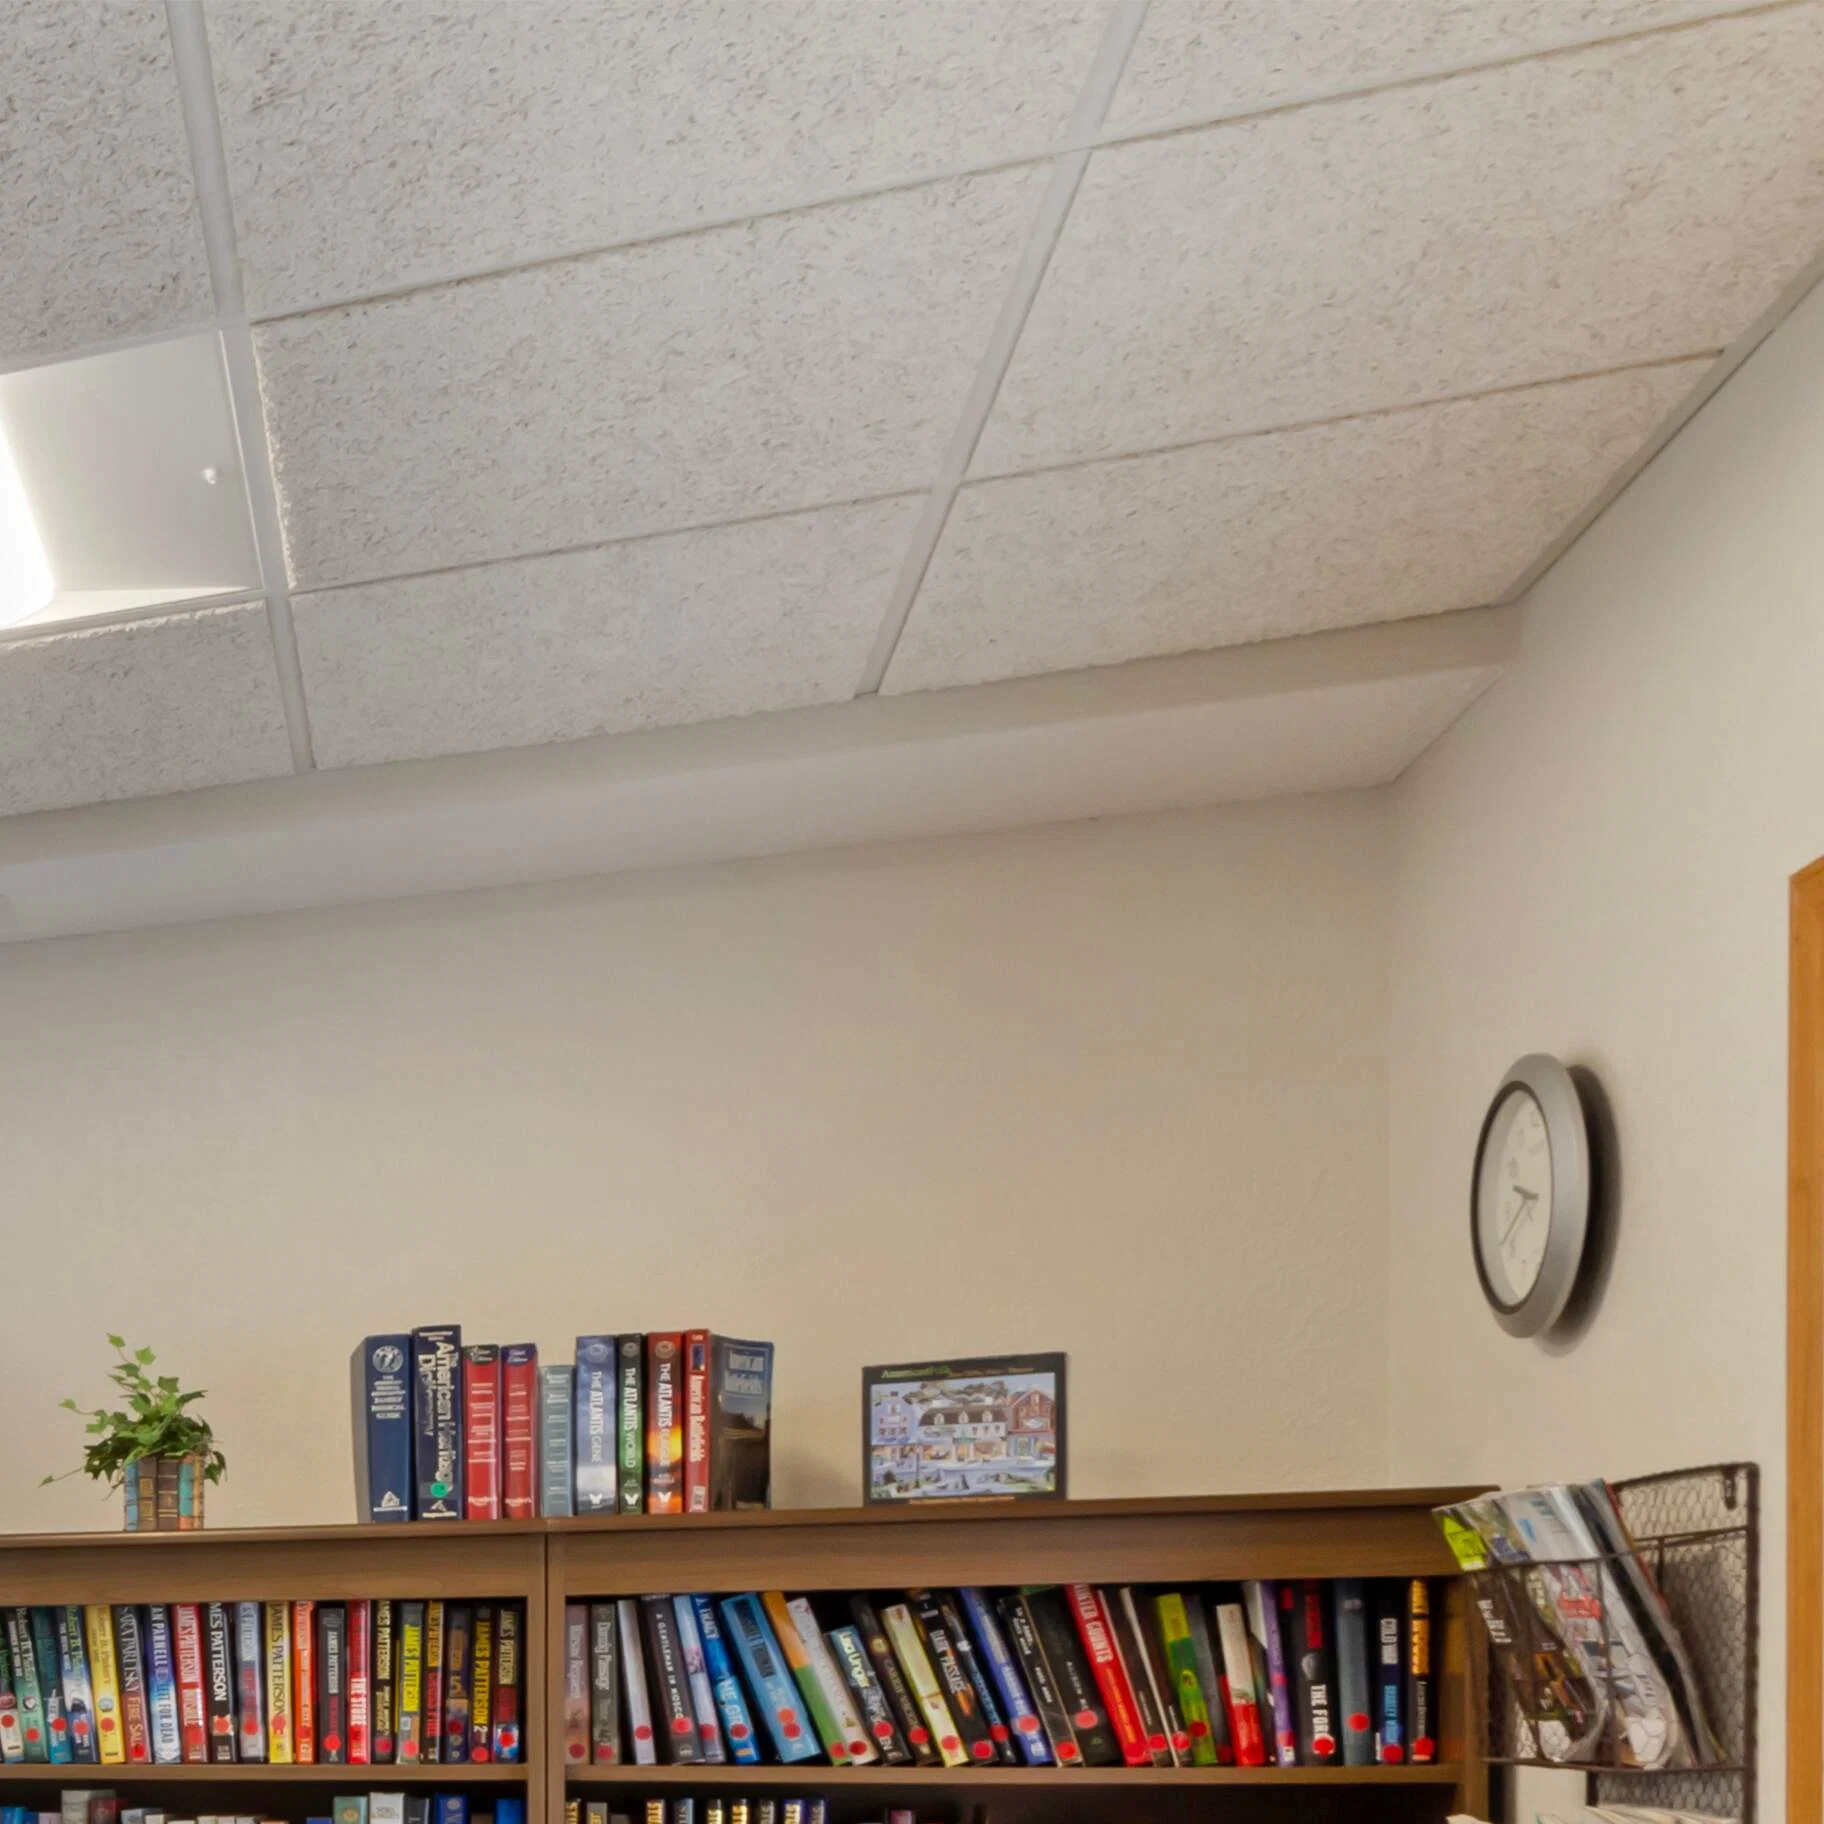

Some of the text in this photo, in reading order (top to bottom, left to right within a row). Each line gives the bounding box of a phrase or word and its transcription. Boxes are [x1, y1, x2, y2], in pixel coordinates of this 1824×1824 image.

[590, 1371, 604, 1462] THE ATLANTIS GENE
[623, 1368, 638, 1468] THE ATLANTIS WORLD
[658, 1362, 672, 1428] THE ATLANTIS
[688, 1374, 704, 1414] American
[152, 1623, 168, 1666] PARNELL
[180, 1634, 199, 1683] PATTERSON
[212, 1630, 227, 1702] PATTERSON
[328, 1630, 338, 1694] JAMES PATTERSON
[376, 1627, 390, 1680] PATTERSON
[403, 1624, 420, 1712] JAMES PATTERSON
[474, 1622, 490, 1725] JAMES PATTERSON
[500, 1639, 514, 1684] PATTERSON
[657, 1622, 674, 1672] GENTLEMAN
[272, 1645, 286, 1717] PATTERSON
[350, 1678, 366, 1727] THE STORE
[1310, 1684, 1328, 1706] THE
